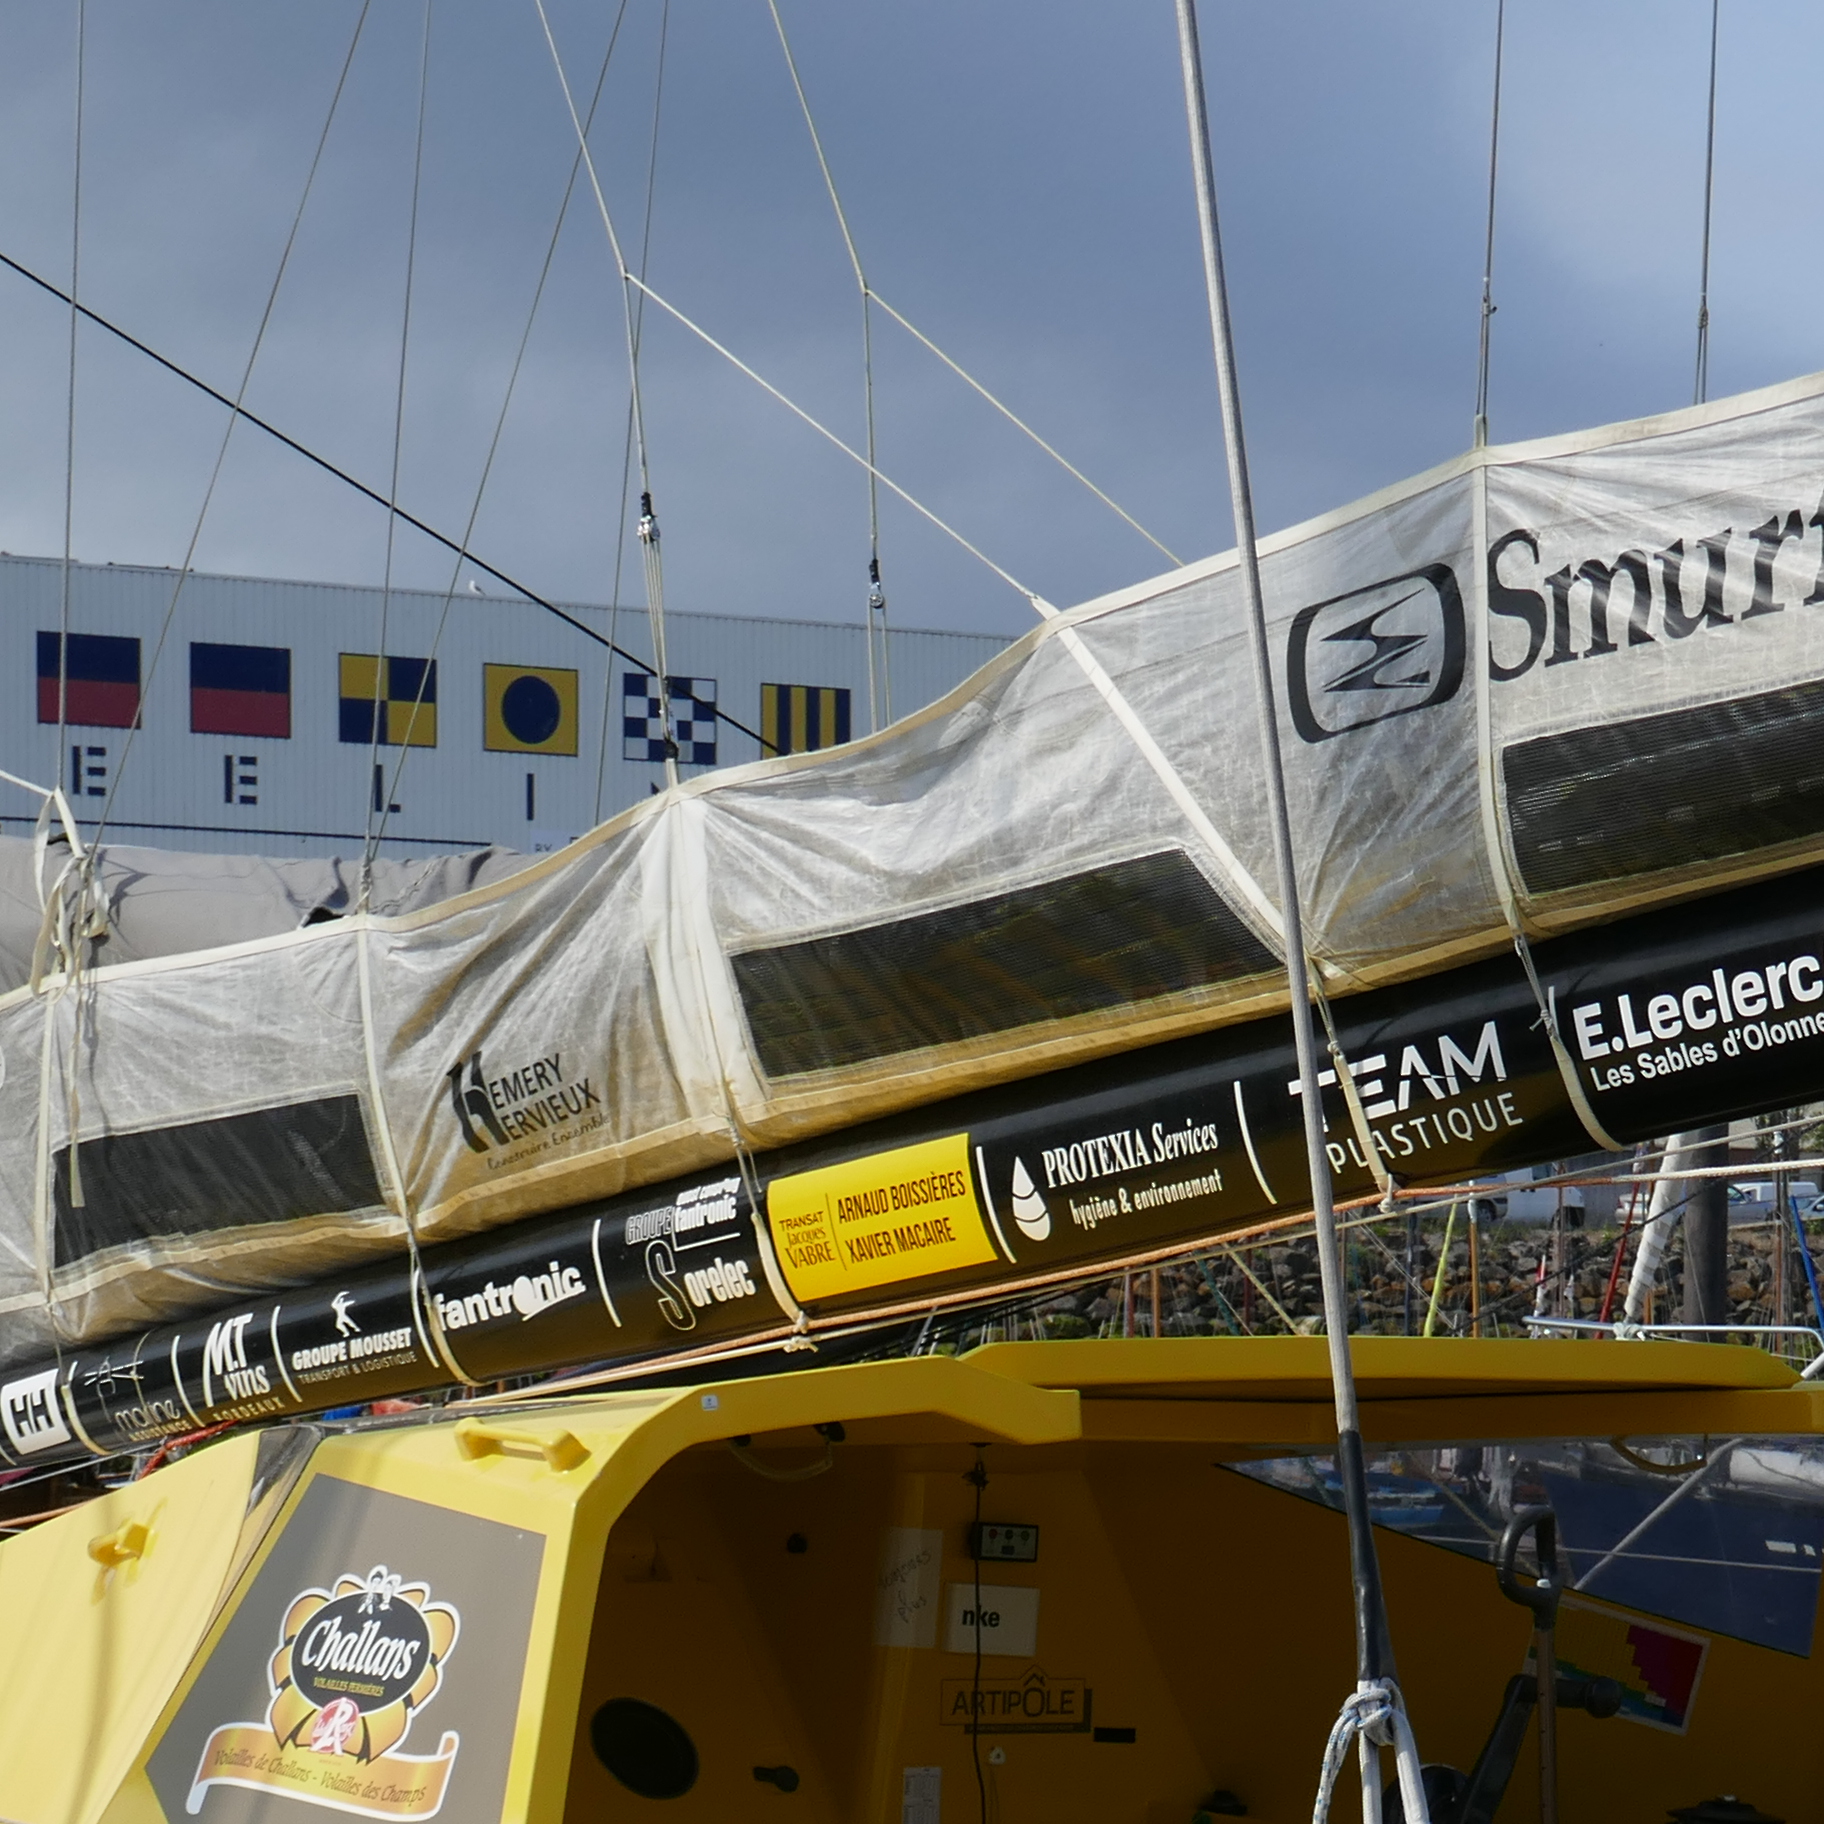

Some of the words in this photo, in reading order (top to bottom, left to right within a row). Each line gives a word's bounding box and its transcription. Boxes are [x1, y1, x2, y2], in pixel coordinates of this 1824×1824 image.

[1573, 956, 1823, 1061] E.Leclerc
[1590, 1062, 1635, 1092] Les
[1637, 1042, 1718, 1080] Sables
[1041, 1128, 1151, 1188] PROTEXIA
[1151, 1118, 1219, 1163] Services
[1325, 1092, 1523, 1174] PLASTIQUE
[837, 1188, 889, 1224] ARNAUD
[890, 1170, 966, 1210] BOISSIÈRES
[1069, 1196, 1118, 1230] hygiène
[1118, 1187, 1133, 1213] &
[1134, 1169, 1223, 1210] environnement
[779, 1211, 824, 1231] TRANSAT
[787, 1225, 826, 1248] Jacques
[845, 1231, 896, 1264] XAVIER
[893, 1217, 956, 1253] MACAIRE
[784, 1241, 837, 1269] VABRE
[433, 1261, 586, 1332] fantronic
[292, 1340, 347, 1371] GROUPE
[350, 1327, 412, 1359] MOUSSET
[298, 1365, 351, 1385] TRANSPORT
[361, 1351, 418, 1374] LOGISTIQUE
[224, 1365, 271, 1400] vins
[213, 1396, 285, 1421] BORDEAUX
[962, 1605, 1001, 1628] nke
[302, 1615, 421, 1681] Challans
[951, 1673, 1075, 1718] ARTIPÔLE
